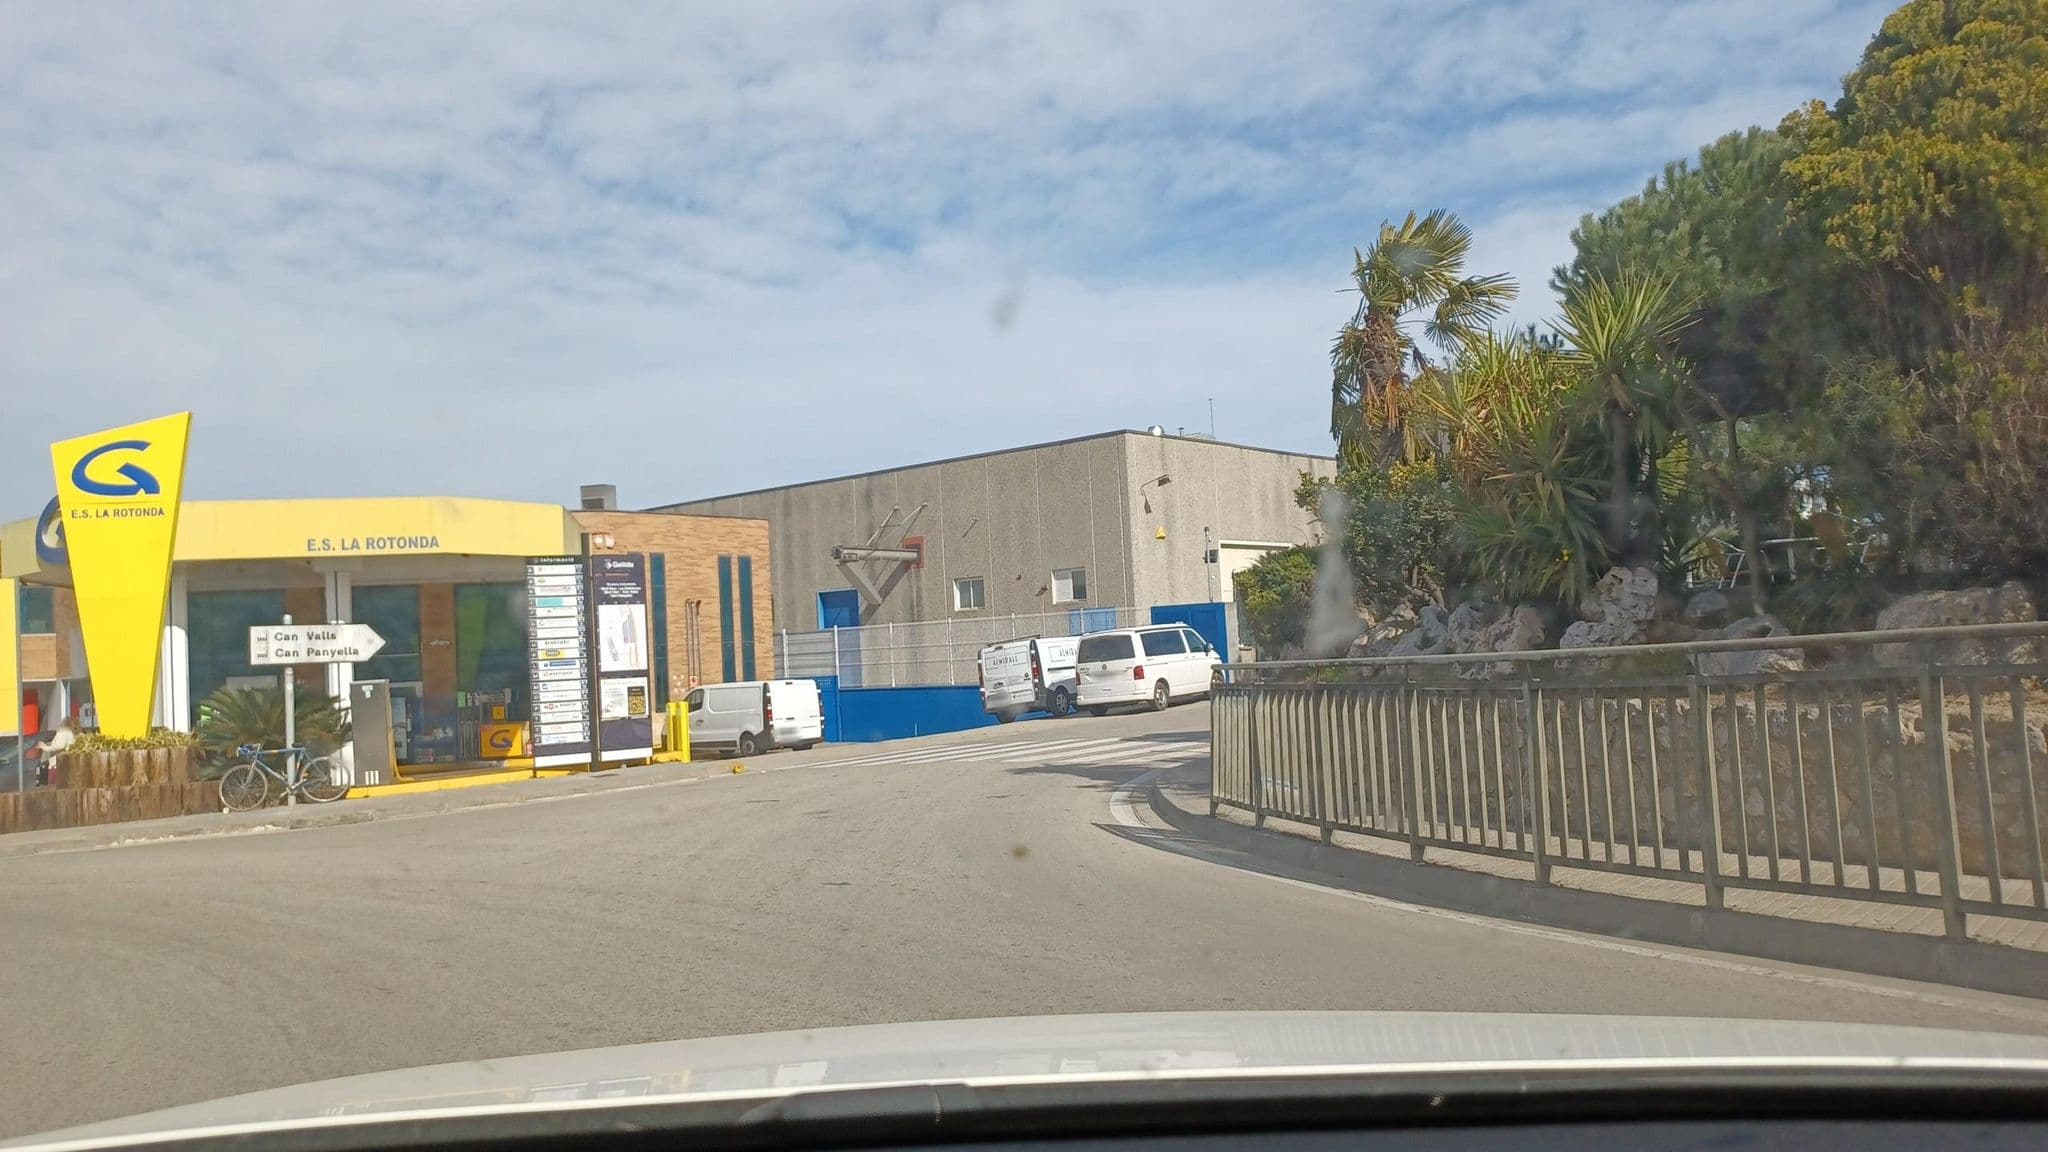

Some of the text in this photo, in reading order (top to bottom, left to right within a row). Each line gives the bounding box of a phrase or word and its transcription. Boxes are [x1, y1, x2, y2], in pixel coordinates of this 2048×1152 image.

[71, 506, 165, 519] E.S. LA ROTONDA
[307, 536, 439, 552] E.S. LA ROTONDA
[274, 631, 337, 641] Can Valls
[275, 646, 359, 658] Can Panyella
